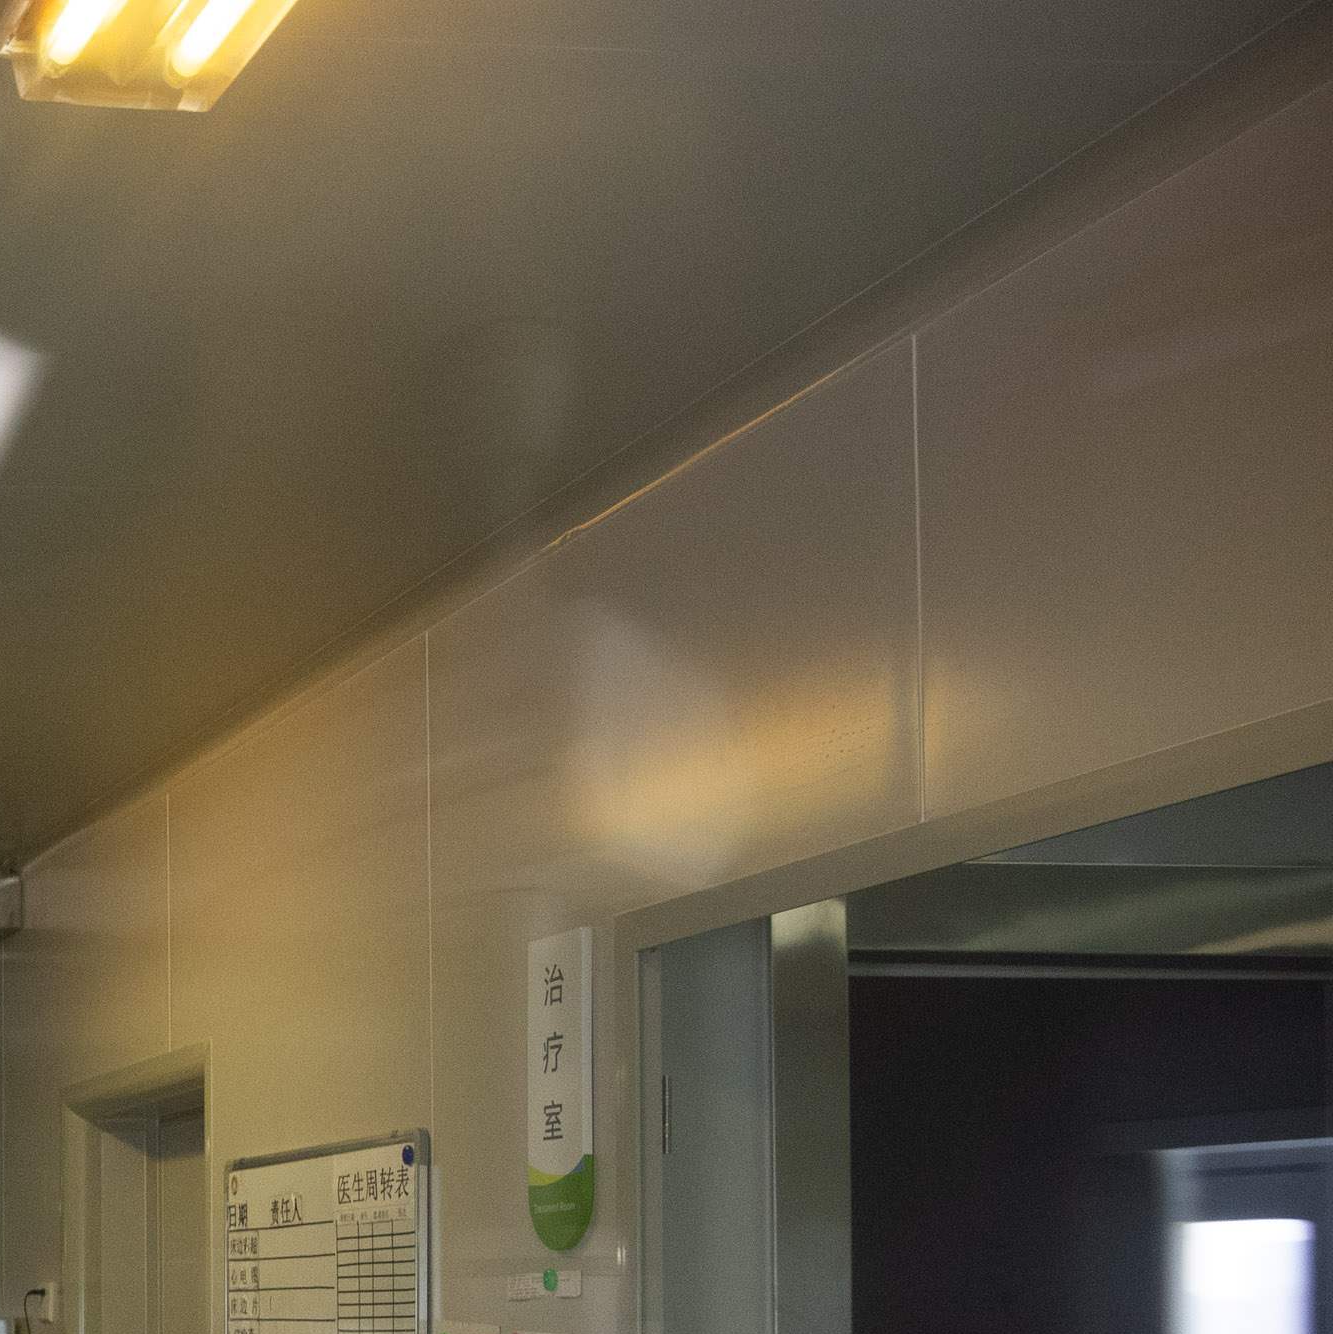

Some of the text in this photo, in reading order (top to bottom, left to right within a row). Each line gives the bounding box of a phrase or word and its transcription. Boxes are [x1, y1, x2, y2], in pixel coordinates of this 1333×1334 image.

[542, 963, 565, 1141] 治疗室
[337, 1165, 410, 1205] 医生周转表
[227, 1197, 303, 1228] 日期 责任人
